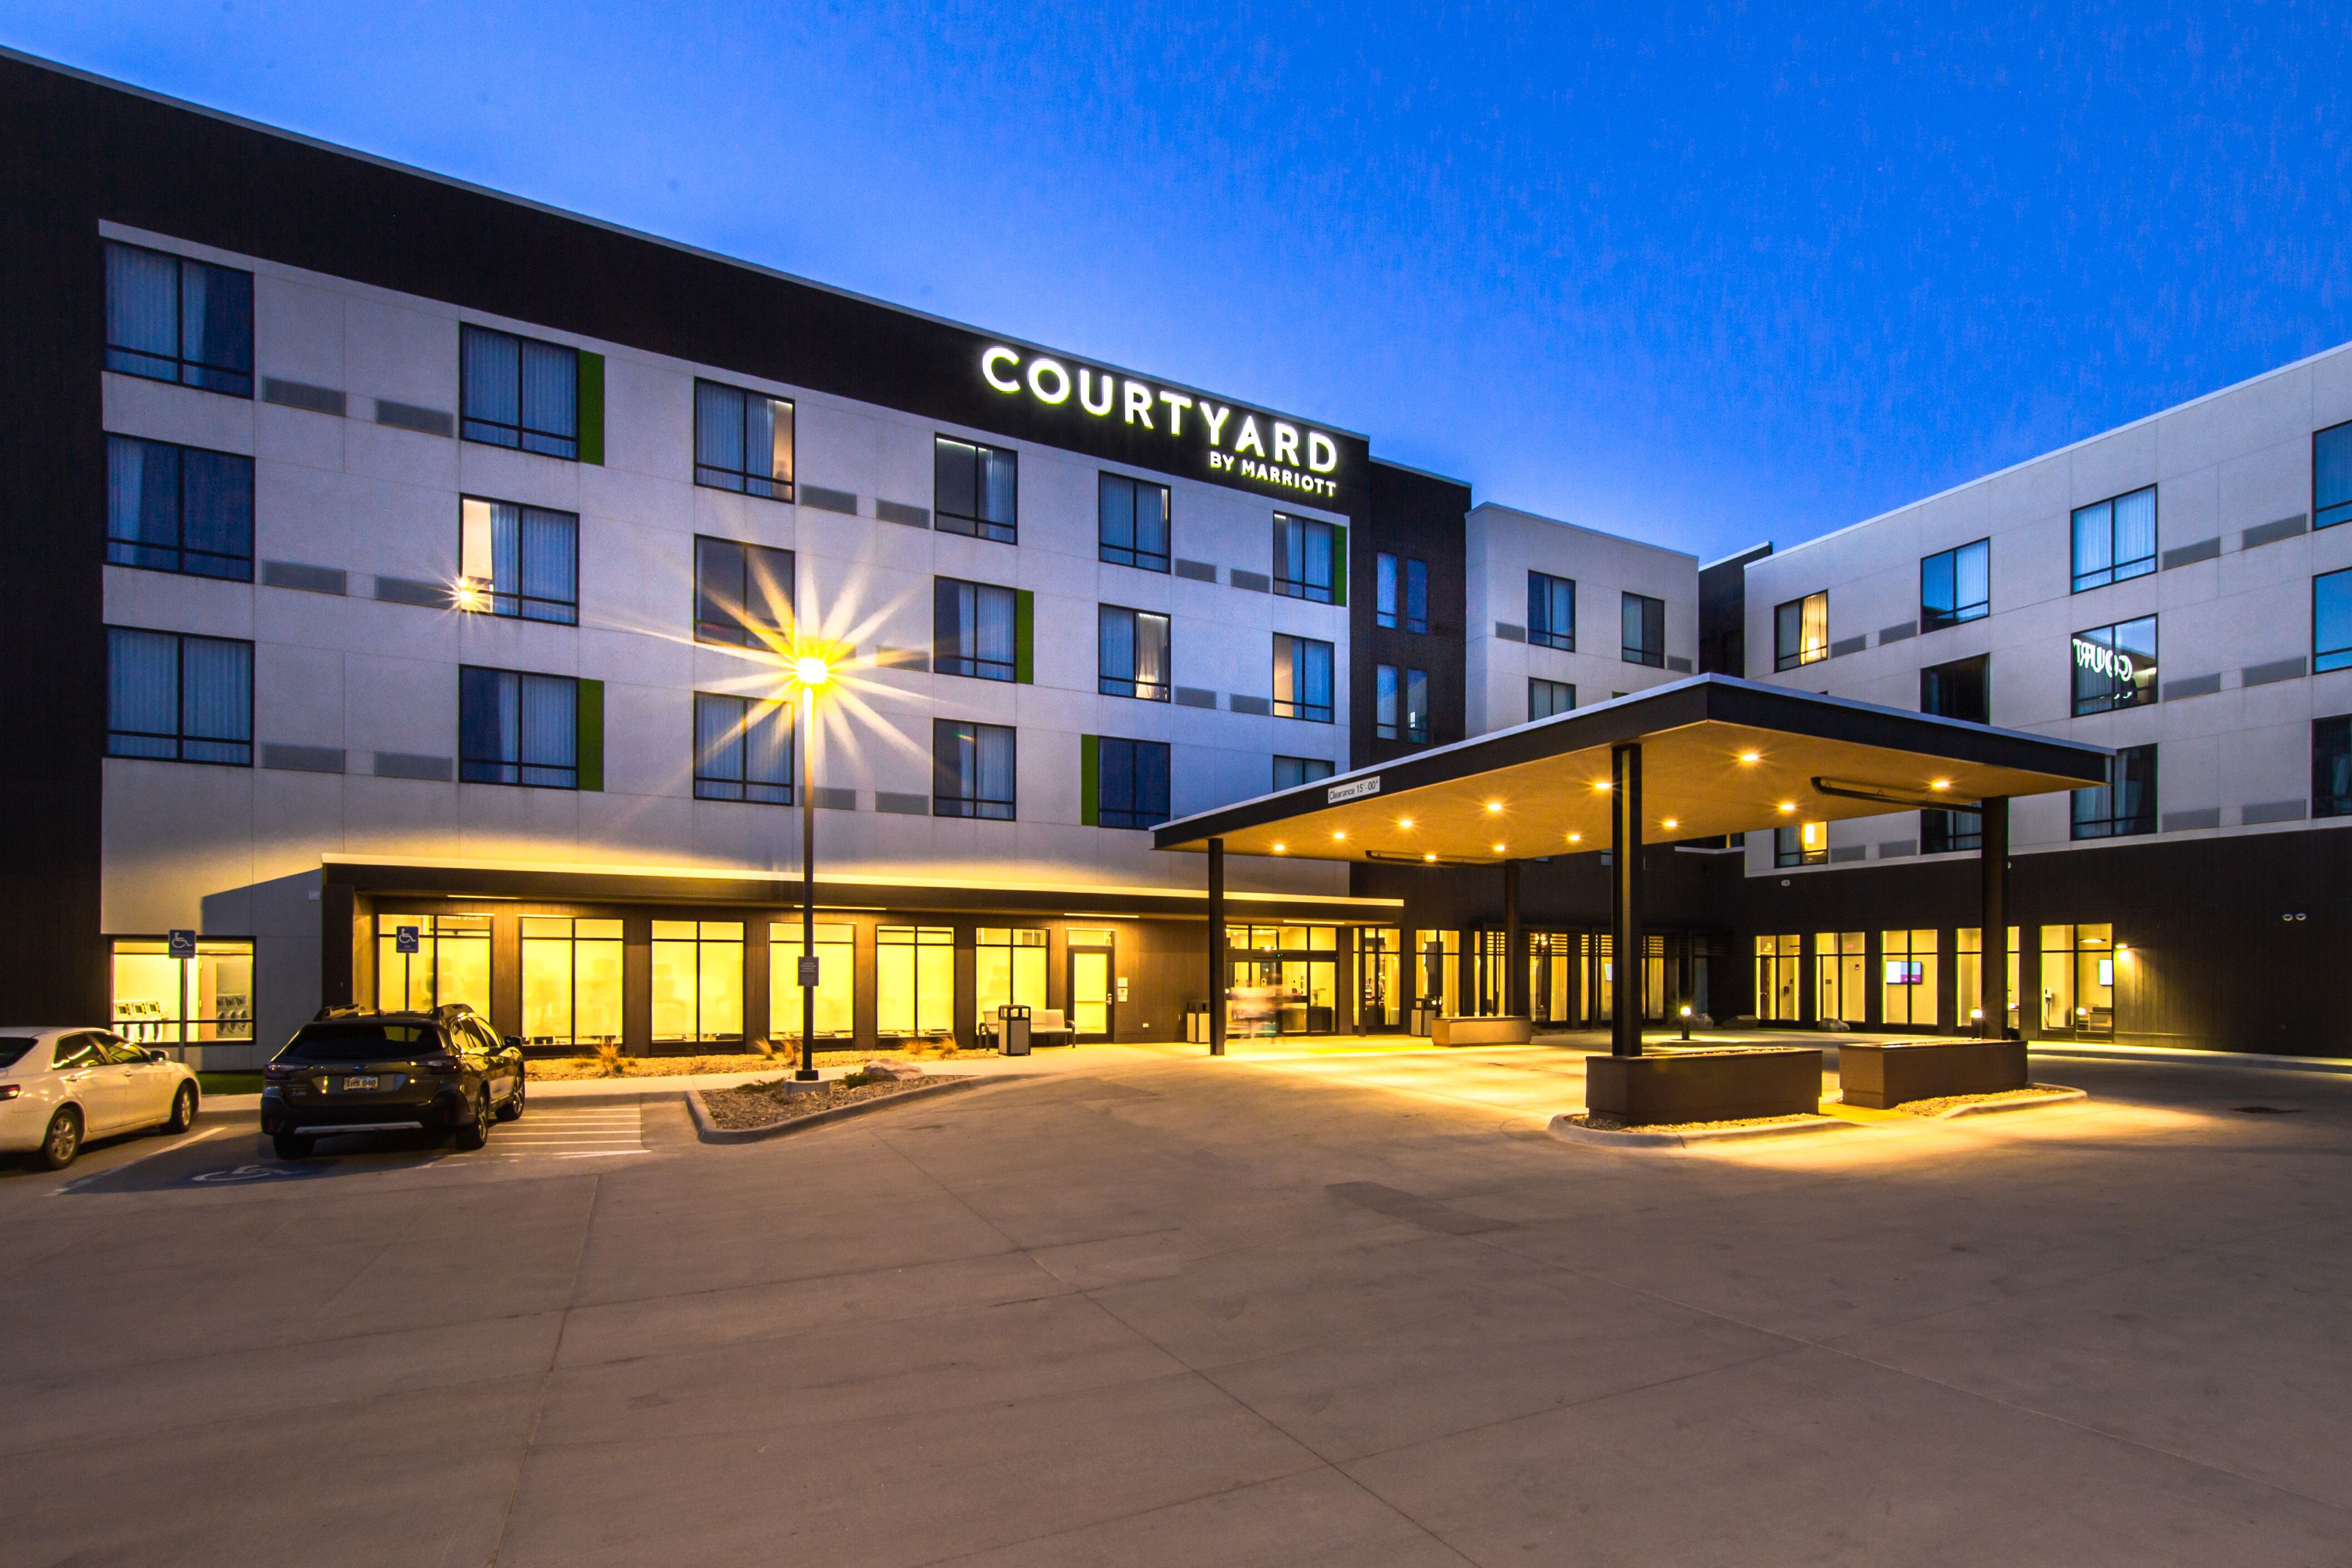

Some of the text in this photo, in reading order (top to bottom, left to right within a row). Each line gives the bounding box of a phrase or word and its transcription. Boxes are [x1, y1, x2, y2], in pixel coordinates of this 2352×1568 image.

[982, 346, 1336, 473] COURTYARD
[1210, 451, 1336, 497] BY MARRIOTT
[1329, 788, 1355, 800] Clearance
